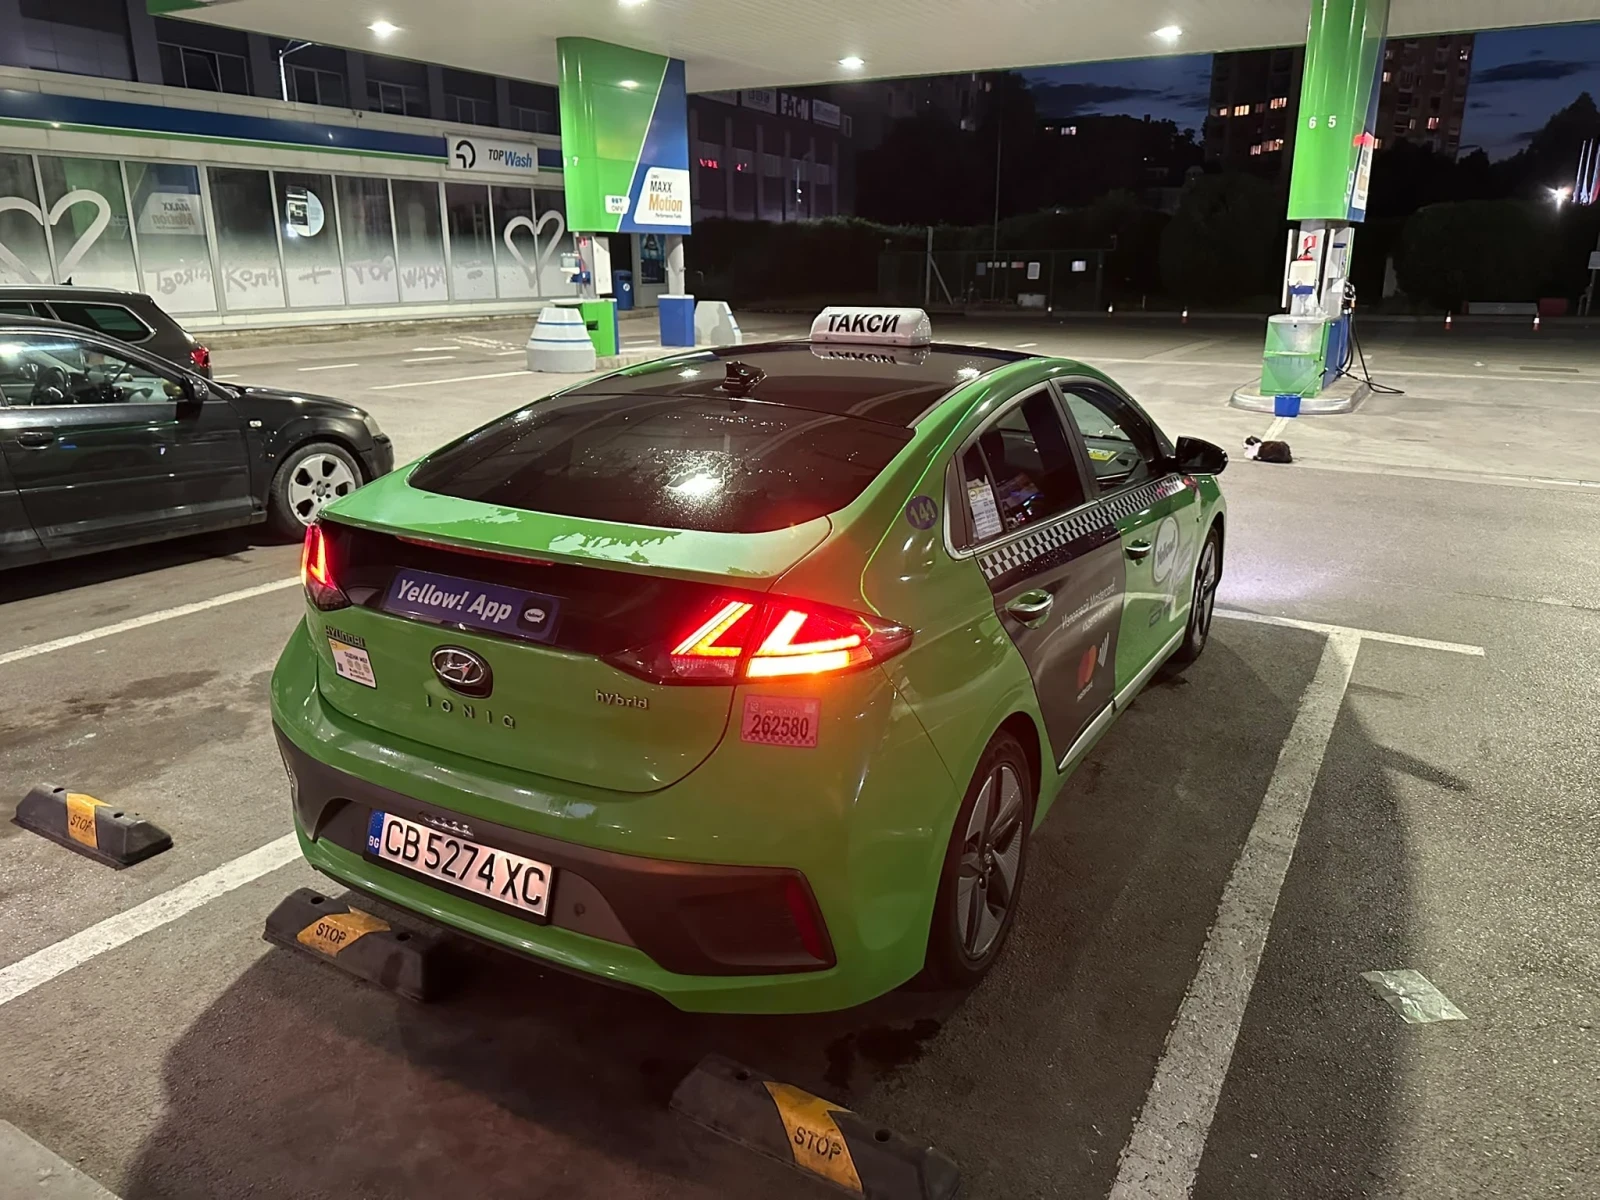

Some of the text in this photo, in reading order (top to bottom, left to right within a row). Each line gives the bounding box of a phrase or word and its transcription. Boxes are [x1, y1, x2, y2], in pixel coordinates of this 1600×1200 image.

[1308, 115, 1337, 129] 6 5
[488, 148, 532, 168] TOP Wash
[572, 156, 579, 167] 7
[649, 180, 672, 193] MAXX
[648, 193, 683, 212] Motion
[827, 313, 901, 333] ТАКСИ
[910, 499, 936, 525] 141
[398, 579, 513, 624] Yellow! App
[595, 689, 649, 710] hybrid
[426, 694, 515, 729] IONIQ
[751, 714, 809, 738] 262580
[70, 814, 93, 832] STOP
[368, 835, 380, 849] BG
[385, 820, 545, 905] CB 5274 XC
[316, 922, 347, 944] STOP
[794, 1126, 842, 1160] STOP
